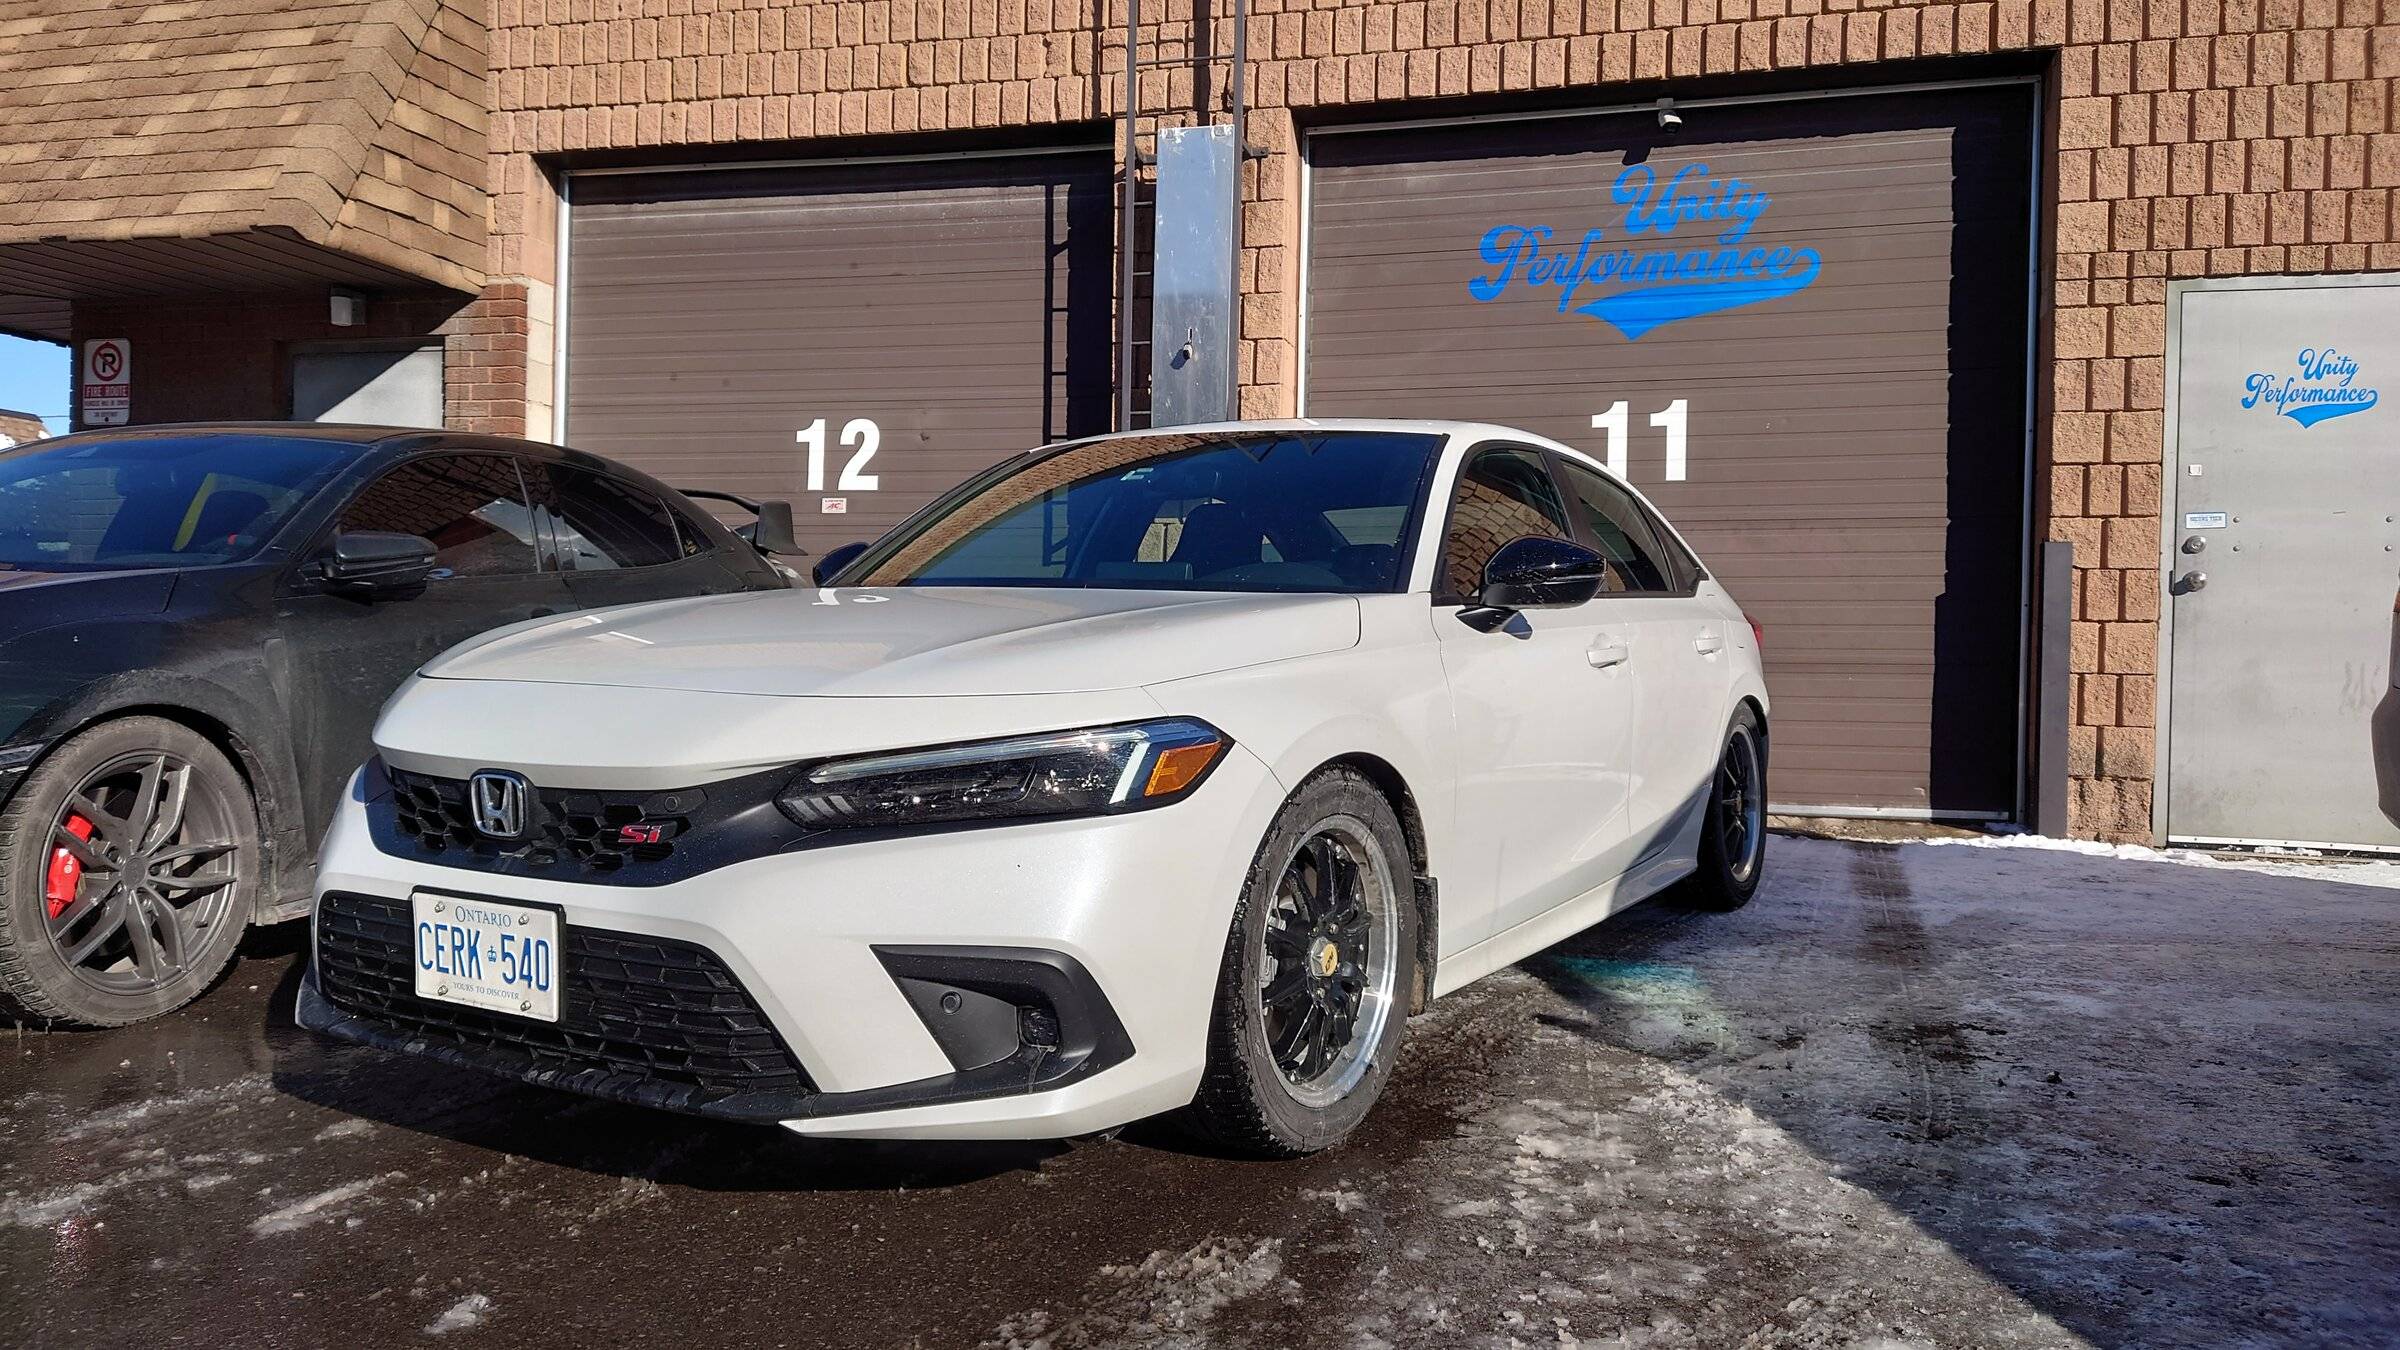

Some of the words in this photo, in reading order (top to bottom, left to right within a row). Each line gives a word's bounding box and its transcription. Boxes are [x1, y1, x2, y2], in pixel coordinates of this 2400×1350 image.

[1611, 163, 1772, 244] Unity
[1469, 224, 1796, 313] Performance
[86, 386, 102, 397] FIRE
[105, 385, 128, 396] ROUTE
[2241, 373, 2368, 416] Performance
[2298, 347, 2360, 386] Unity
[796, 418, 880, 491] 12
[1592, 399, 1688, 481] 11
[455, 905, 511, 928] ONTARIO
[418, 922, 483, 980] CERK
[500, 933, 550, 992] 540
[453, 981, 474, 992] YOURS
[476, 985, 485, 994] TO
[487, 987, 520, 1000] DISCOVER
